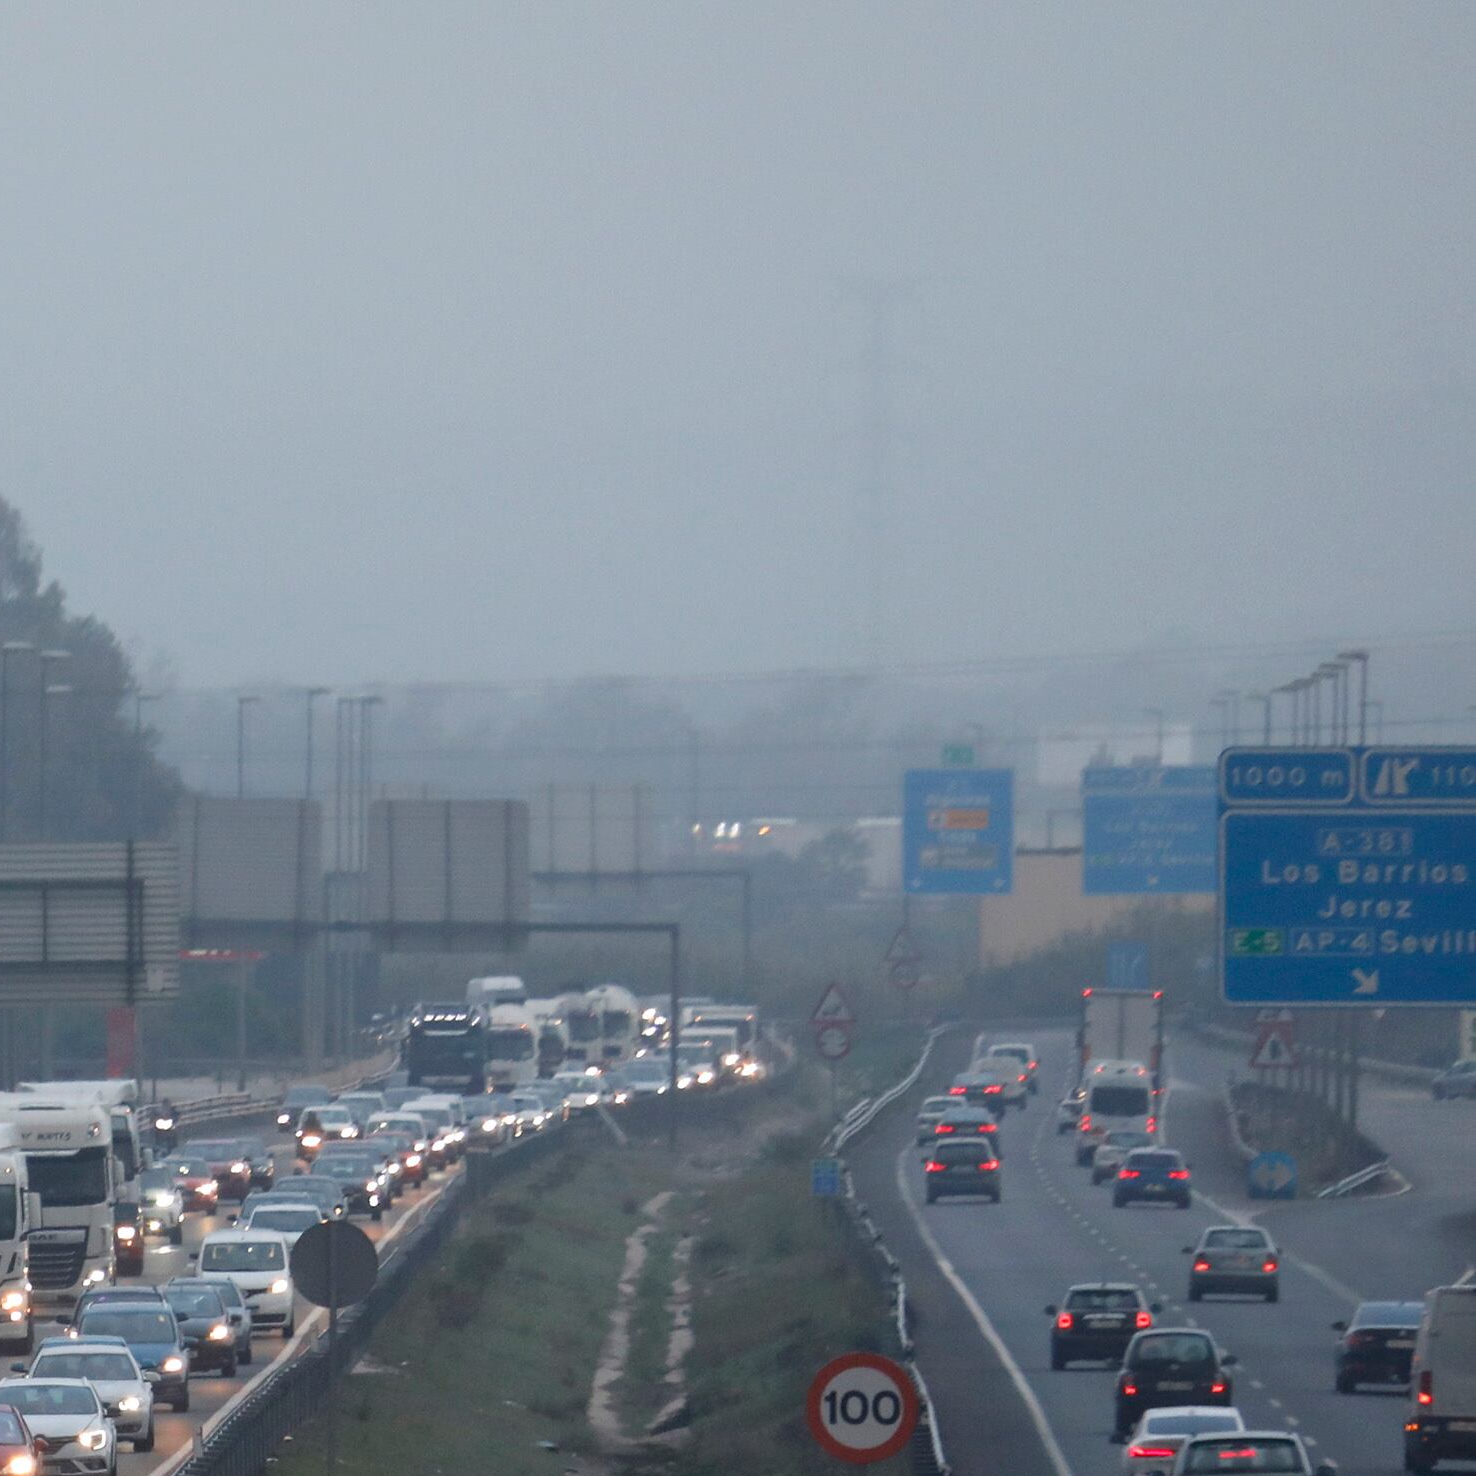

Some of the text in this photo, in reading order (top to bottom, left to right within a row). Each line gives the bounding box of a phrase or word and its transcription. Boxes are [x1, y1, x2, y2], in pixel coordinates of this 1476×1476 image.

[1231, 766, 1345, 785] 1000 m
[1322, 831, 1412, 852] A-381
[1261, 859, 1468, 884] Los Barrios
[1317, 896, 1414, 919] Jerez
[1295, 931, 1370, 951] AP-4
[823, 1389, 901, 1427] 100
